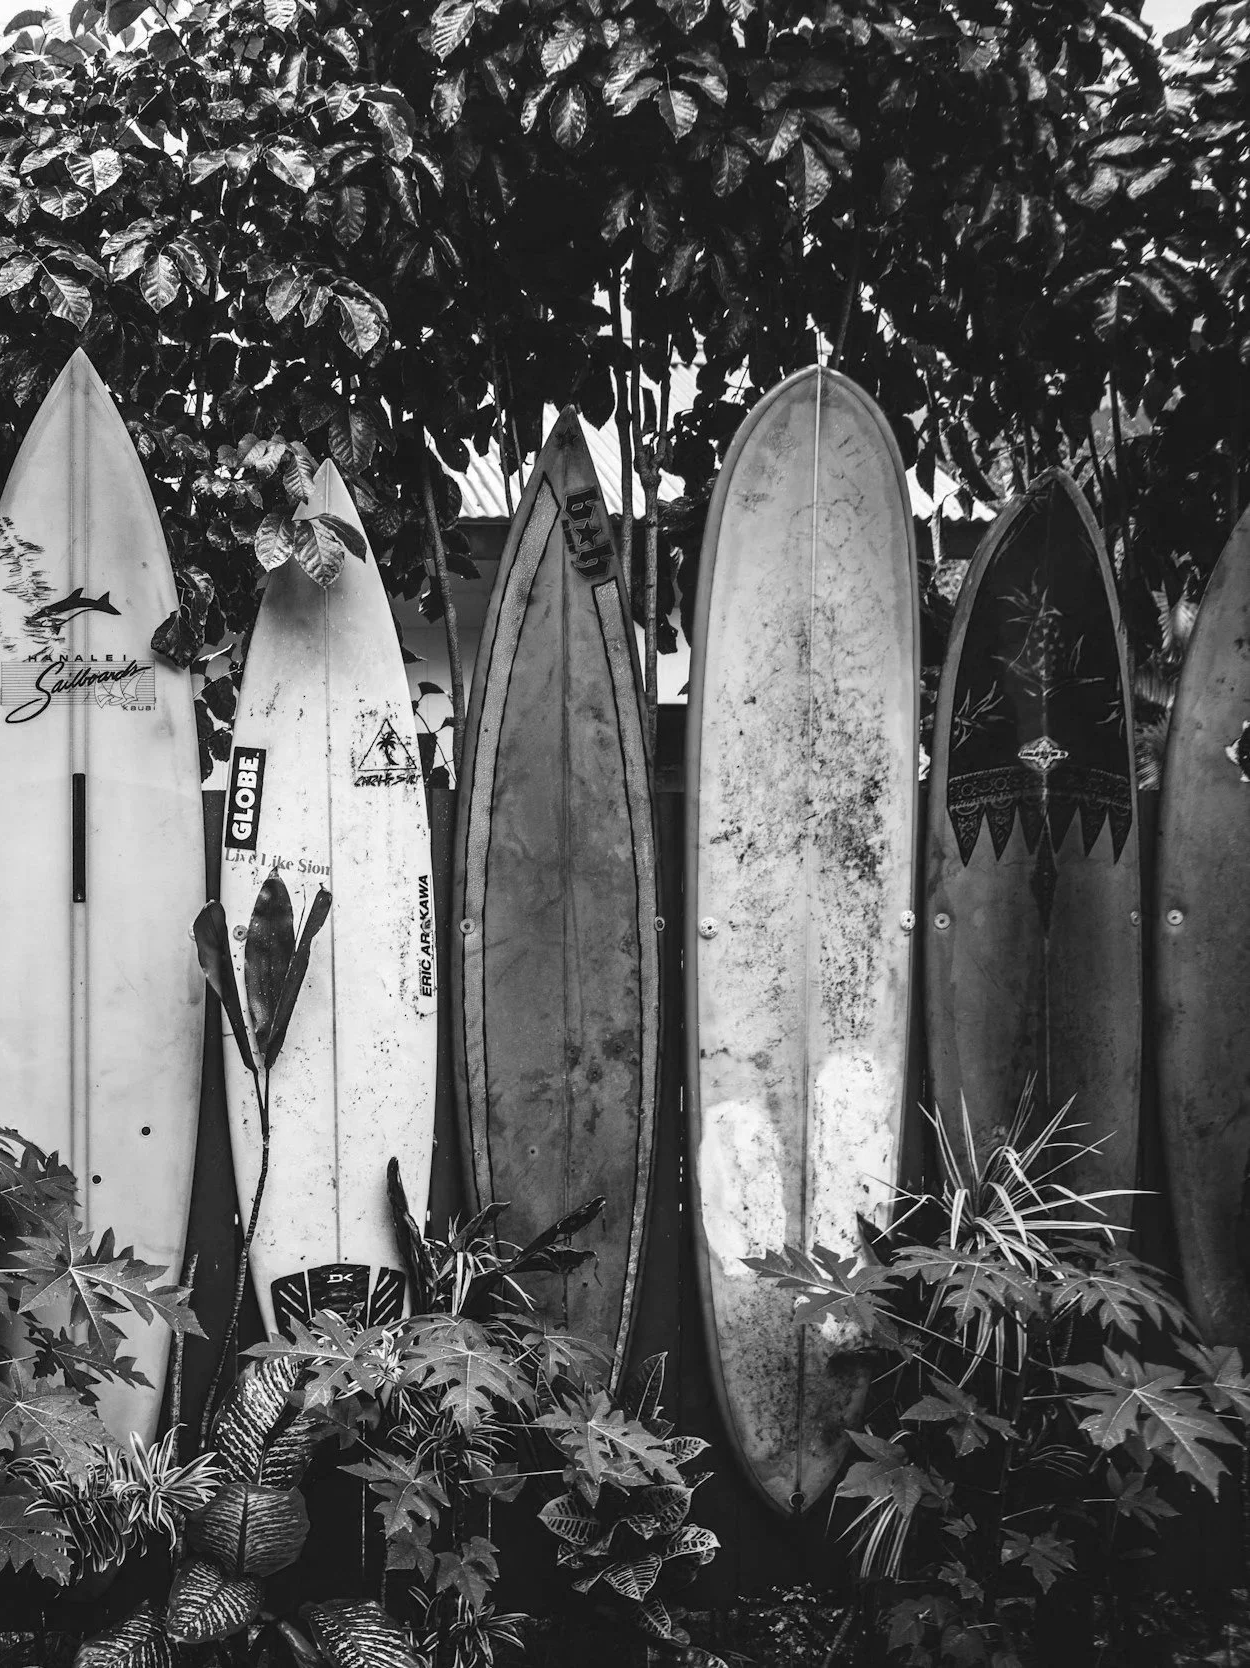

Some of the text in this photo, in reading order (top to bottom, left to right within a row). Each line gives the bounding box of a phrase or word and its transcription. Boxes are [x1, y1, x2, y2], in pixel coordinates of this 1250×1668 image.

[28, 654, 127, 663] HANALEI
[5, 660, 152, 724] Sailboards
[419, 875, 431, 956] ARKAWA
[421, 959, 432, 997] ERIC
